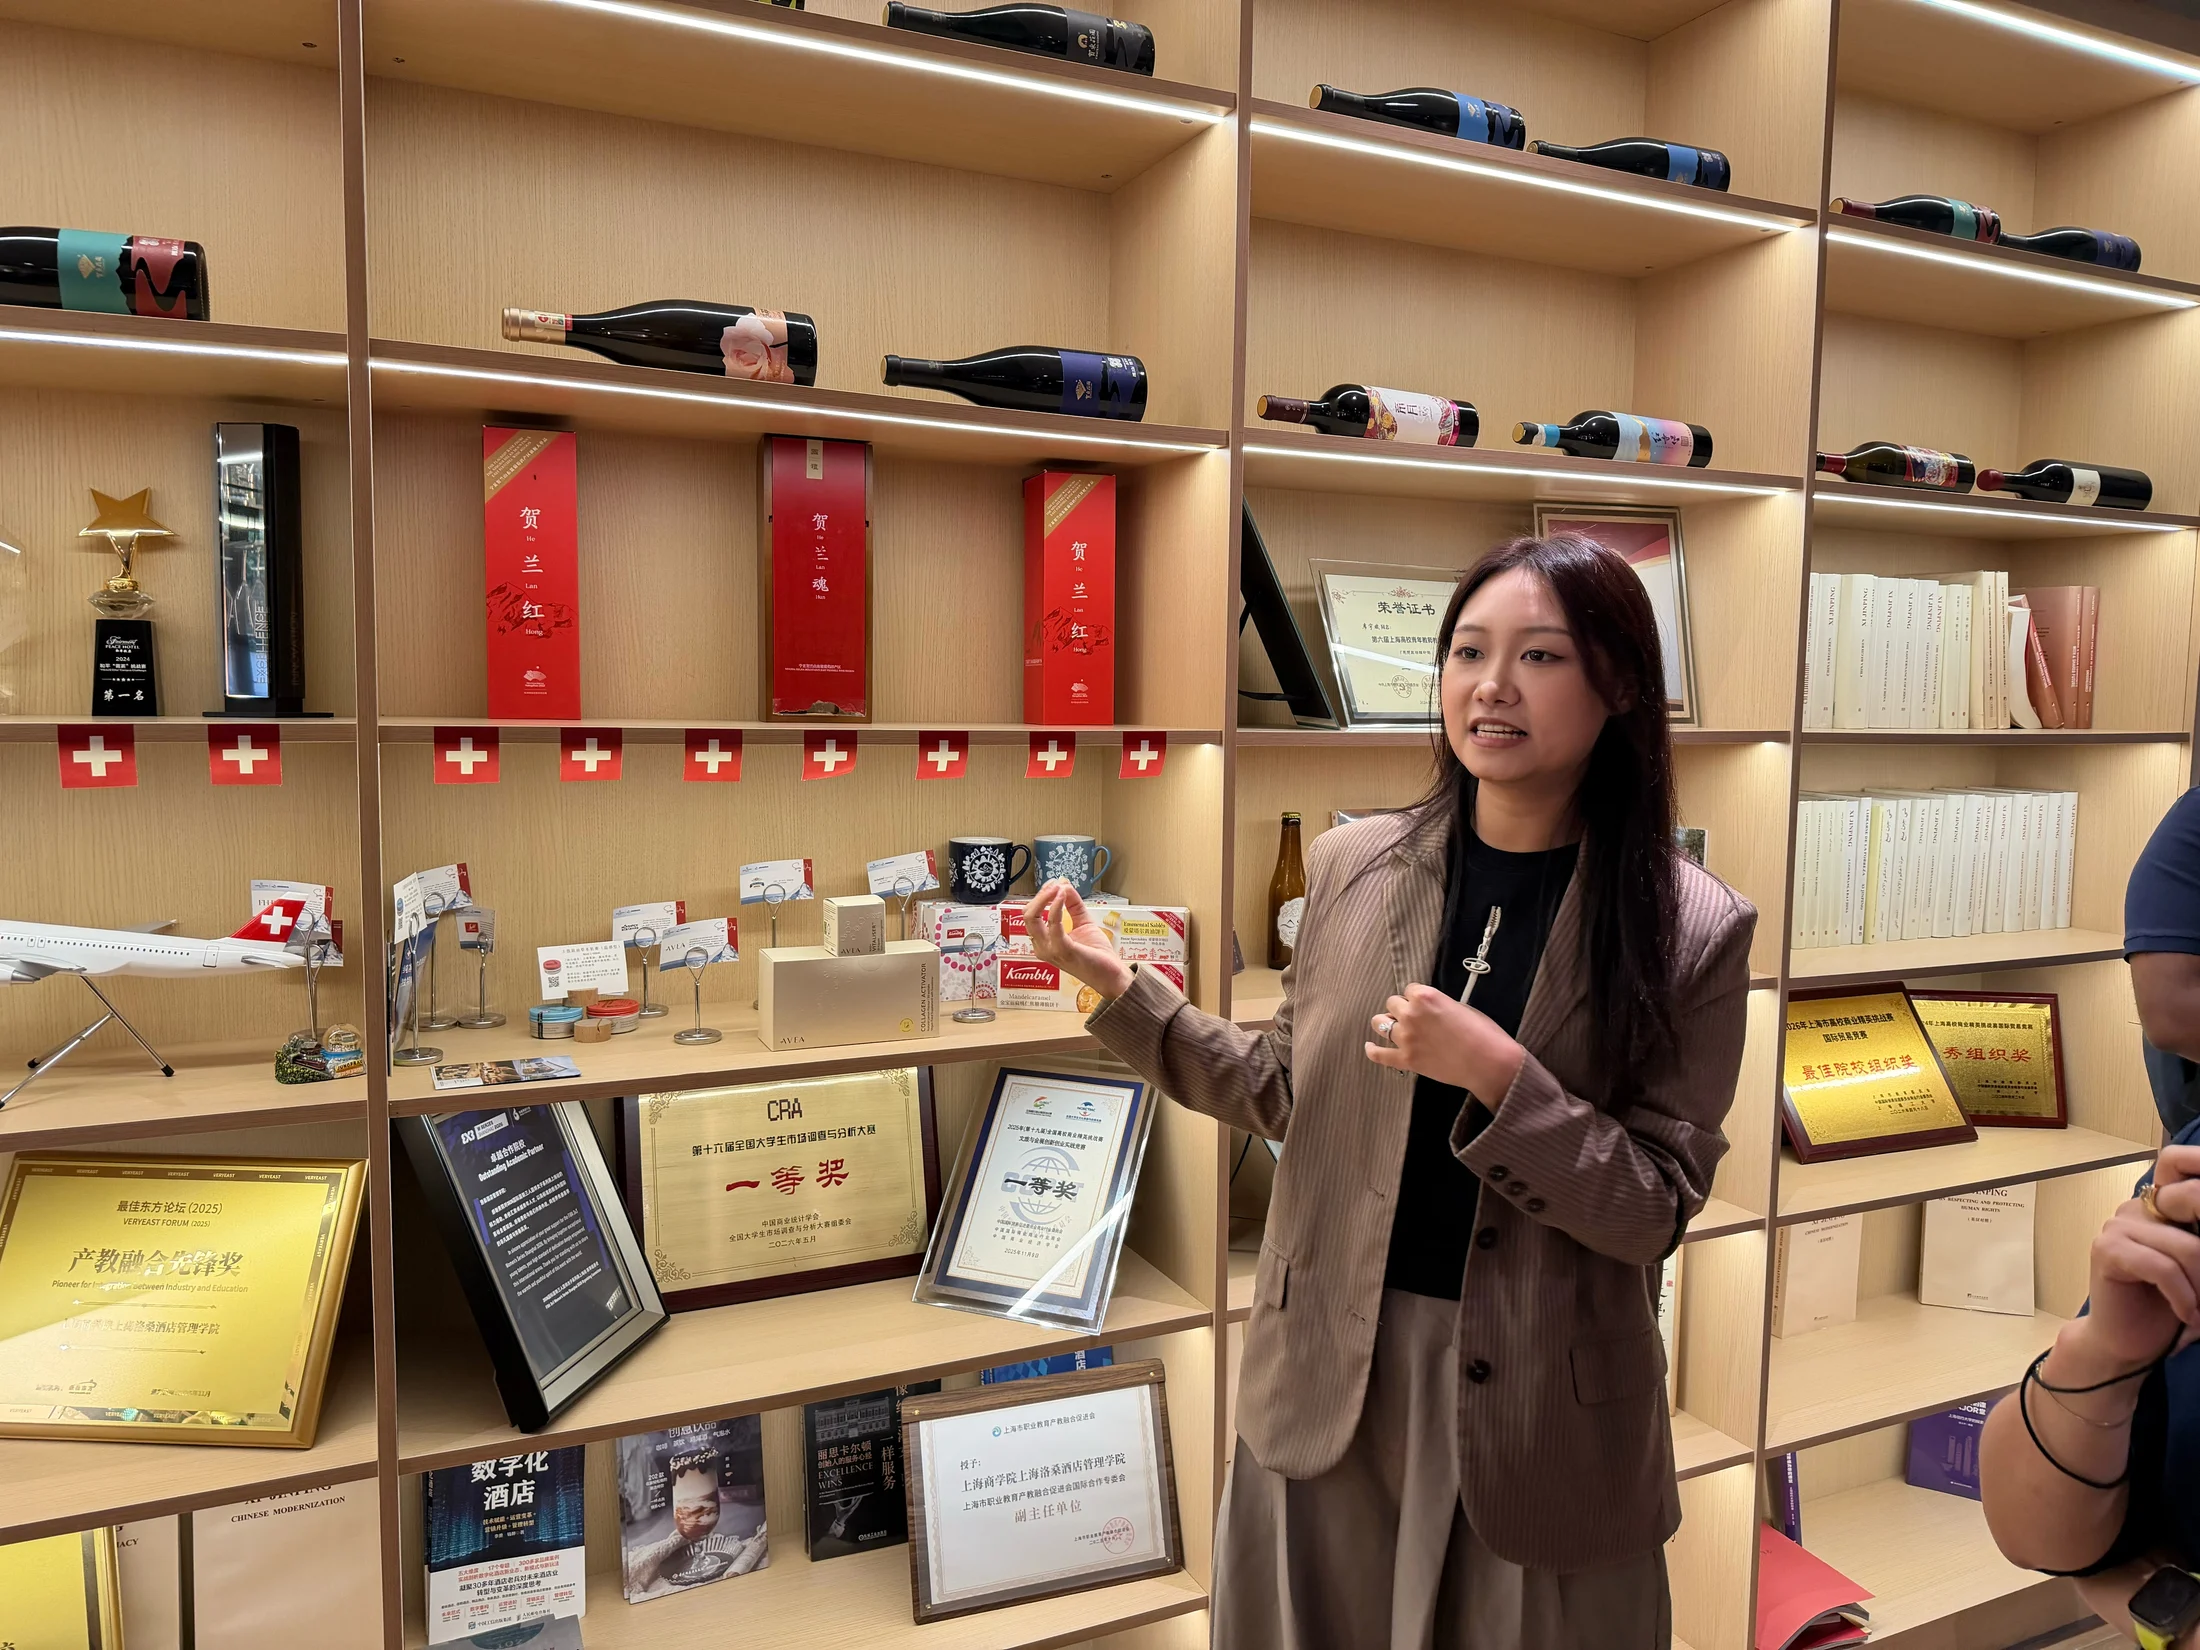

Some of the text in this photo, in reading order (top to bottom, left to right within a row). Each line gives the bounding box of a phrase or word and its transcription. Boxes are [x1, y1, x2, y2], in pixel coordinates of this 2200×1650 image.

[520, 507, 540, 529] 贺
[812, 513, 828, 532] 贺
[815, 546, 829, 560] 兰
[1071, 542, 1088, 561] 贺
[522, 554, 544, 574] 兰
[812, 576, 829, 592] 魂
[1072, 583, 1088, 599] 兰
[522, 600, 544, 620] 红
[1378, 602, 1436, 616] 荣誉证书
[1071, 623, 1088, 638] 红
[254, 603, 268, 684] EXCELLENCE
[104, 689, 144, 701] 第一名
[666, 942, 686, 952] AVEA
[1006, 967, 1055, 985] Kambly
[1822, 1030, 1868, 1043] 国际贸易竞赛
[1944, 1046, 2031, 1062] 秀组织奖
[1802, 1054, 1917, 1081] 最佳院校组织奖
[767, 1098, 802, 1122] CRA
[490, 1139, 526, 1162] 卓越合作院校
[692, 1124, 876, 1157] 第十六届全国大学生市场调查与分析大赛
[478, 1144, 544, 1182] Outstanding Academic Partner
[725, 1158, 850, 1195] 一等奖
[1004, 1177, 1079, 1200] 一等奖
[123, 1218, 160, 1226] VERYEAST
[162, 1219, 189, 1227] FORUM
[762, 1212, 820, 1228] 中国商业统计学会
[729, 1218, 852, 1243] 全国大学生市场调查与分析大赛组委会
[68, 1248, 244, 1277] 产教融合先锋奖
[52, 1280, 79, 1289] Pioneer
[80, 1280, 92, 1289] for
[133, 1282, 163, 1291] Between
[165, 1283, 196, 1293] Industry
[212, 1284, 248, 1293] Education
[1003, 1412, 1095, 1434] 上海市职业教育产教融合促进会
[818, 1440, 871, 1460] 丽思卡尔顿
[471, 1450, 549, 1483] 数字化
[818, 1462, 873, 1479] EXCELLENCE
[961, 1452, 1126, 1493] 上海商学院上海洛桑酒店管理学院
[819, 1479, 843, 1490] WINS
[963, 1473, 1126, 1511] 上海市职业教育产教融合促进会国际合作专委会
[483, 1480, 536, 1510] 酒店
[231, 1496, 346, 1523] CHINESE MODERNIZATION
[1014, 1499, 1082, 1524] 副主任单位
[476, 1580, 542, 1597] 转型与变革的深度思考
